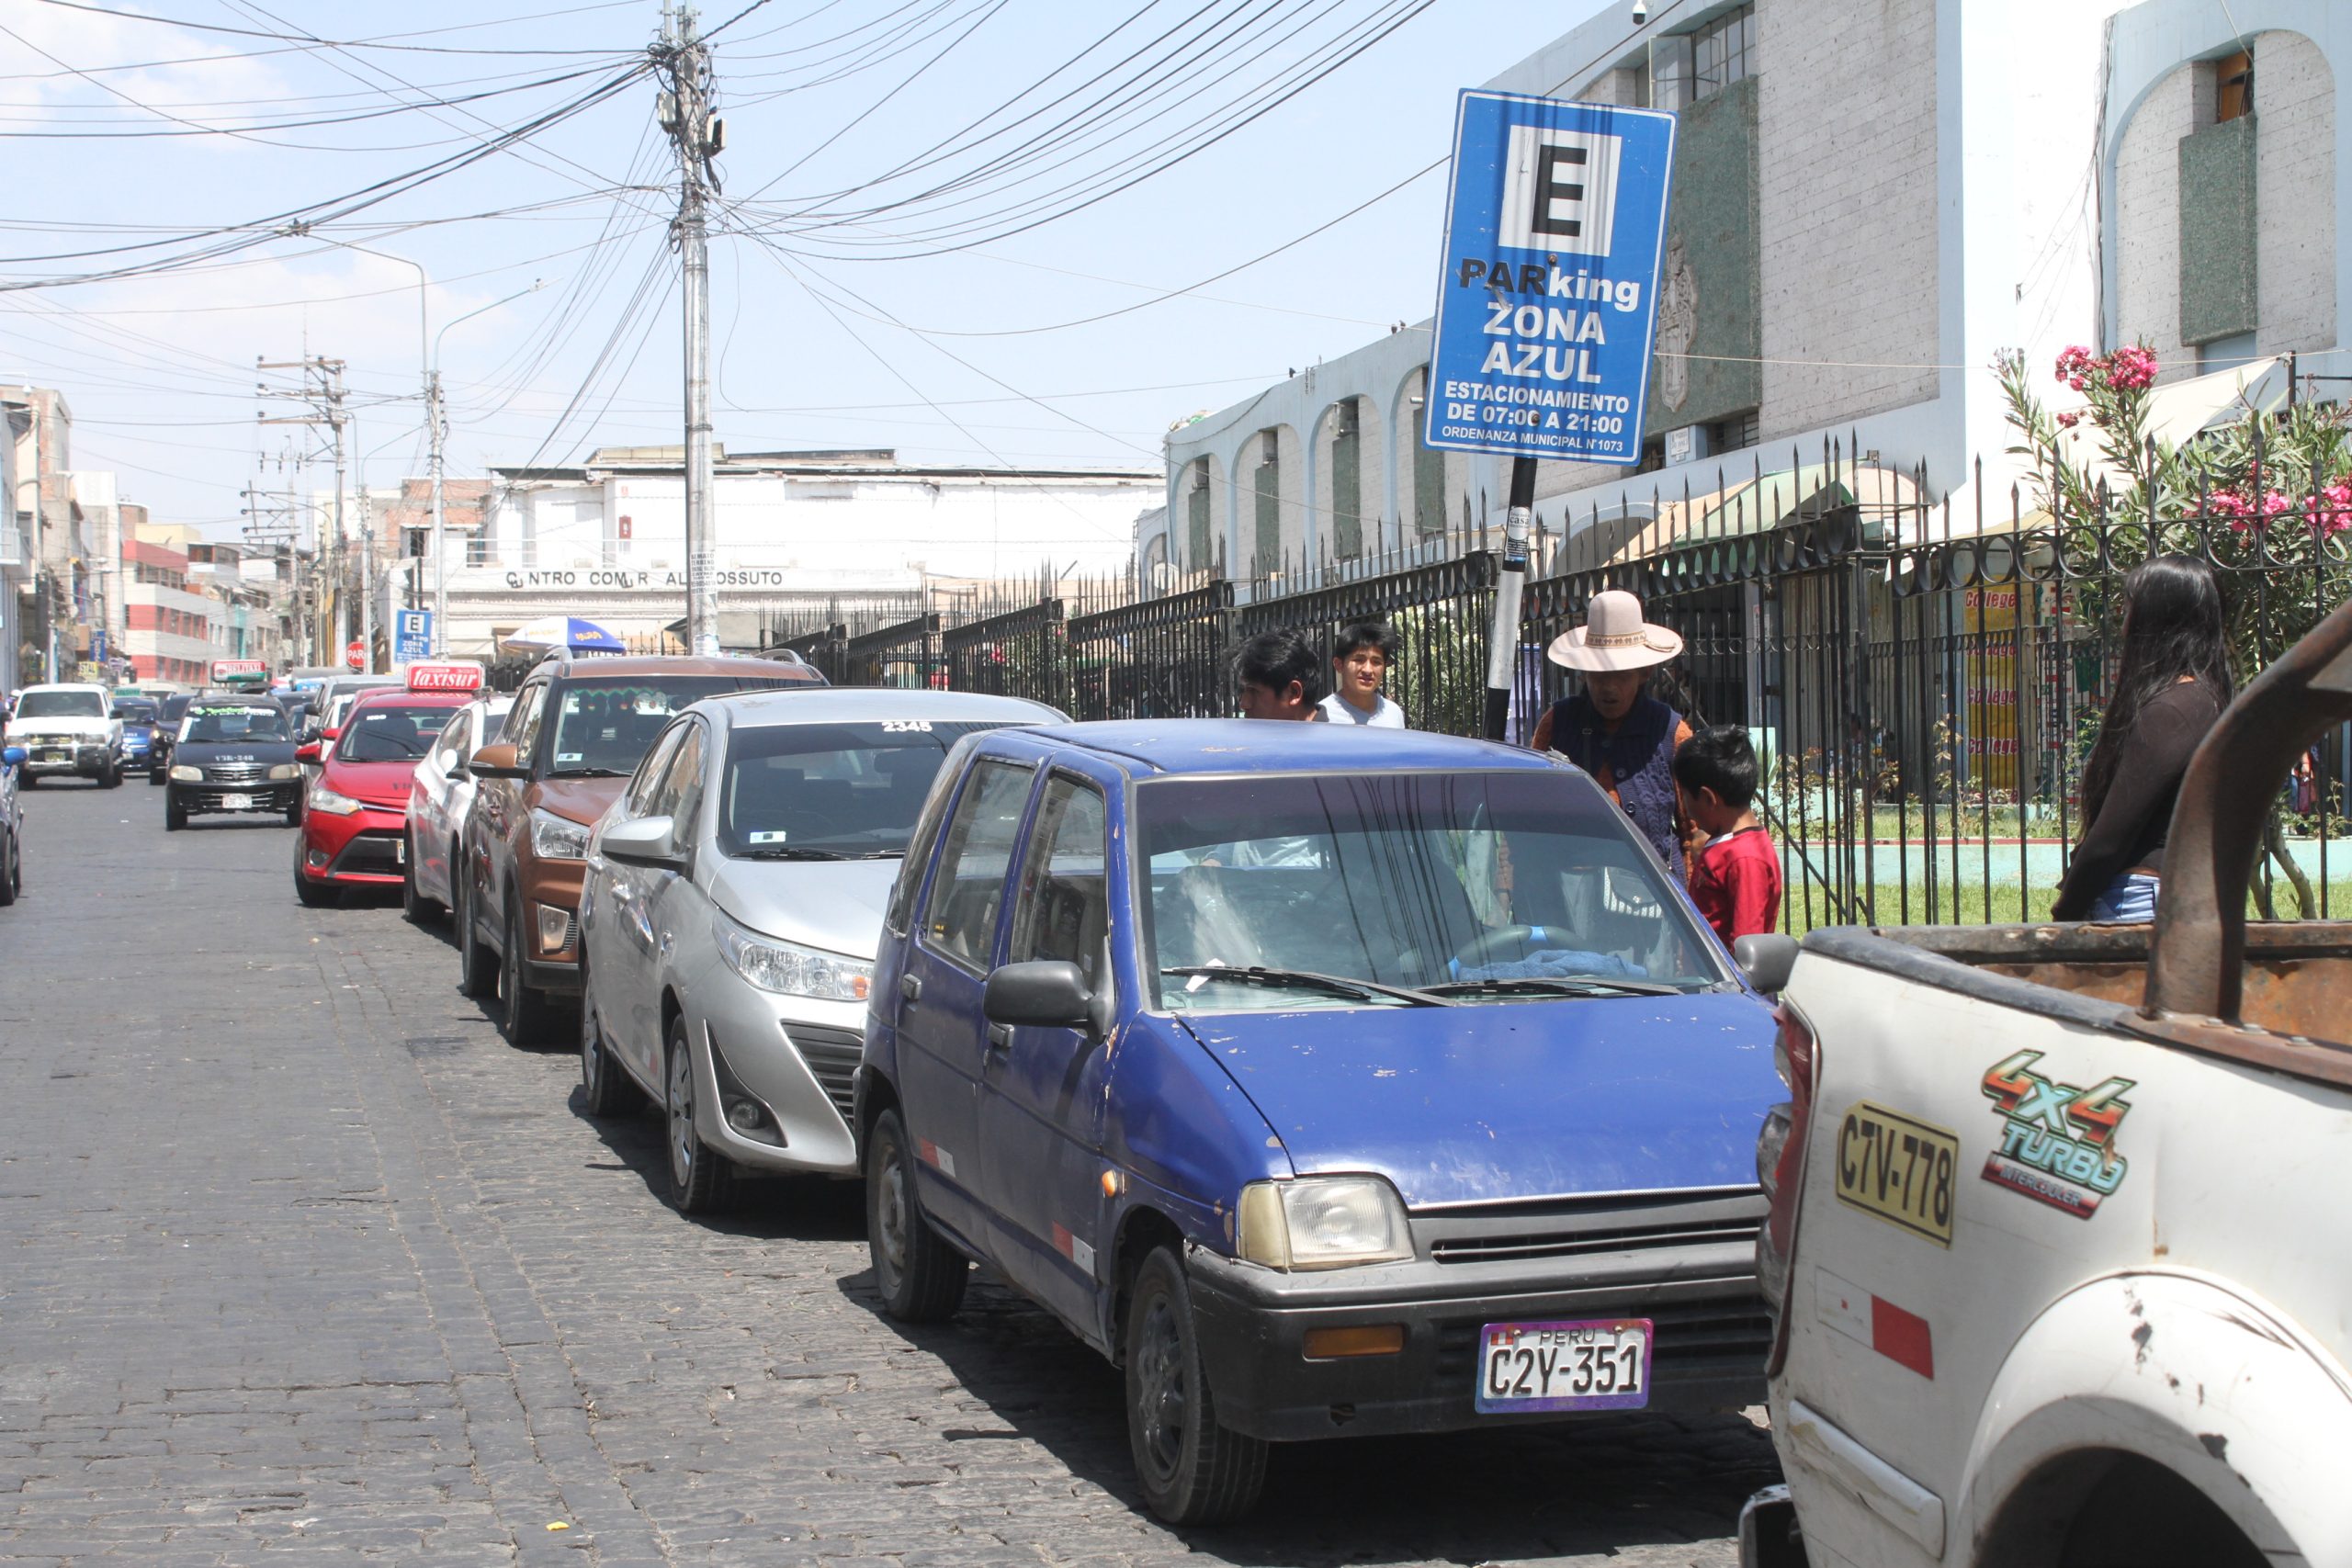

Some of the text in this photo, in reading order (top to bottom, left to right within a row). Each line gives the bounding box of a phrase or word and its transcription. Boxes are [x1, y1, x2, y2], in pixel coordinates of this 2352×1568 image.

[1532, 144, 1588, 238] E
[1483, 301, 1606, 345] ZONA
[1480, 341, 1601, 384] AZUL
[1444, 380, 1630, 413] ESTACIONAMIENTO
[1447, 402, 1623, 434] DE 07:00 A 21:00
[1442, 425, 1517, 443] ORDENANZA
[1521, 433, 1583, 449] MUNICIPAL
[1965, 591, 2016, 609] Colege
[410, 616, 419, 631] E
[347, 649, 365, 660] PAR
[413, 669, 478, 687] taxisur
[882, 721, 933, 732] 2345
[1841, 1113, 1951, 1227] C7V-778
[2002, 1119, 2128, 1196] TURBO
[1999, 1165, 2083, 1207] INTERCOOLER
[1540, 1328, 1596, 1344] PERU
[1489, 1346, 1637, 1395] C2Y-351
